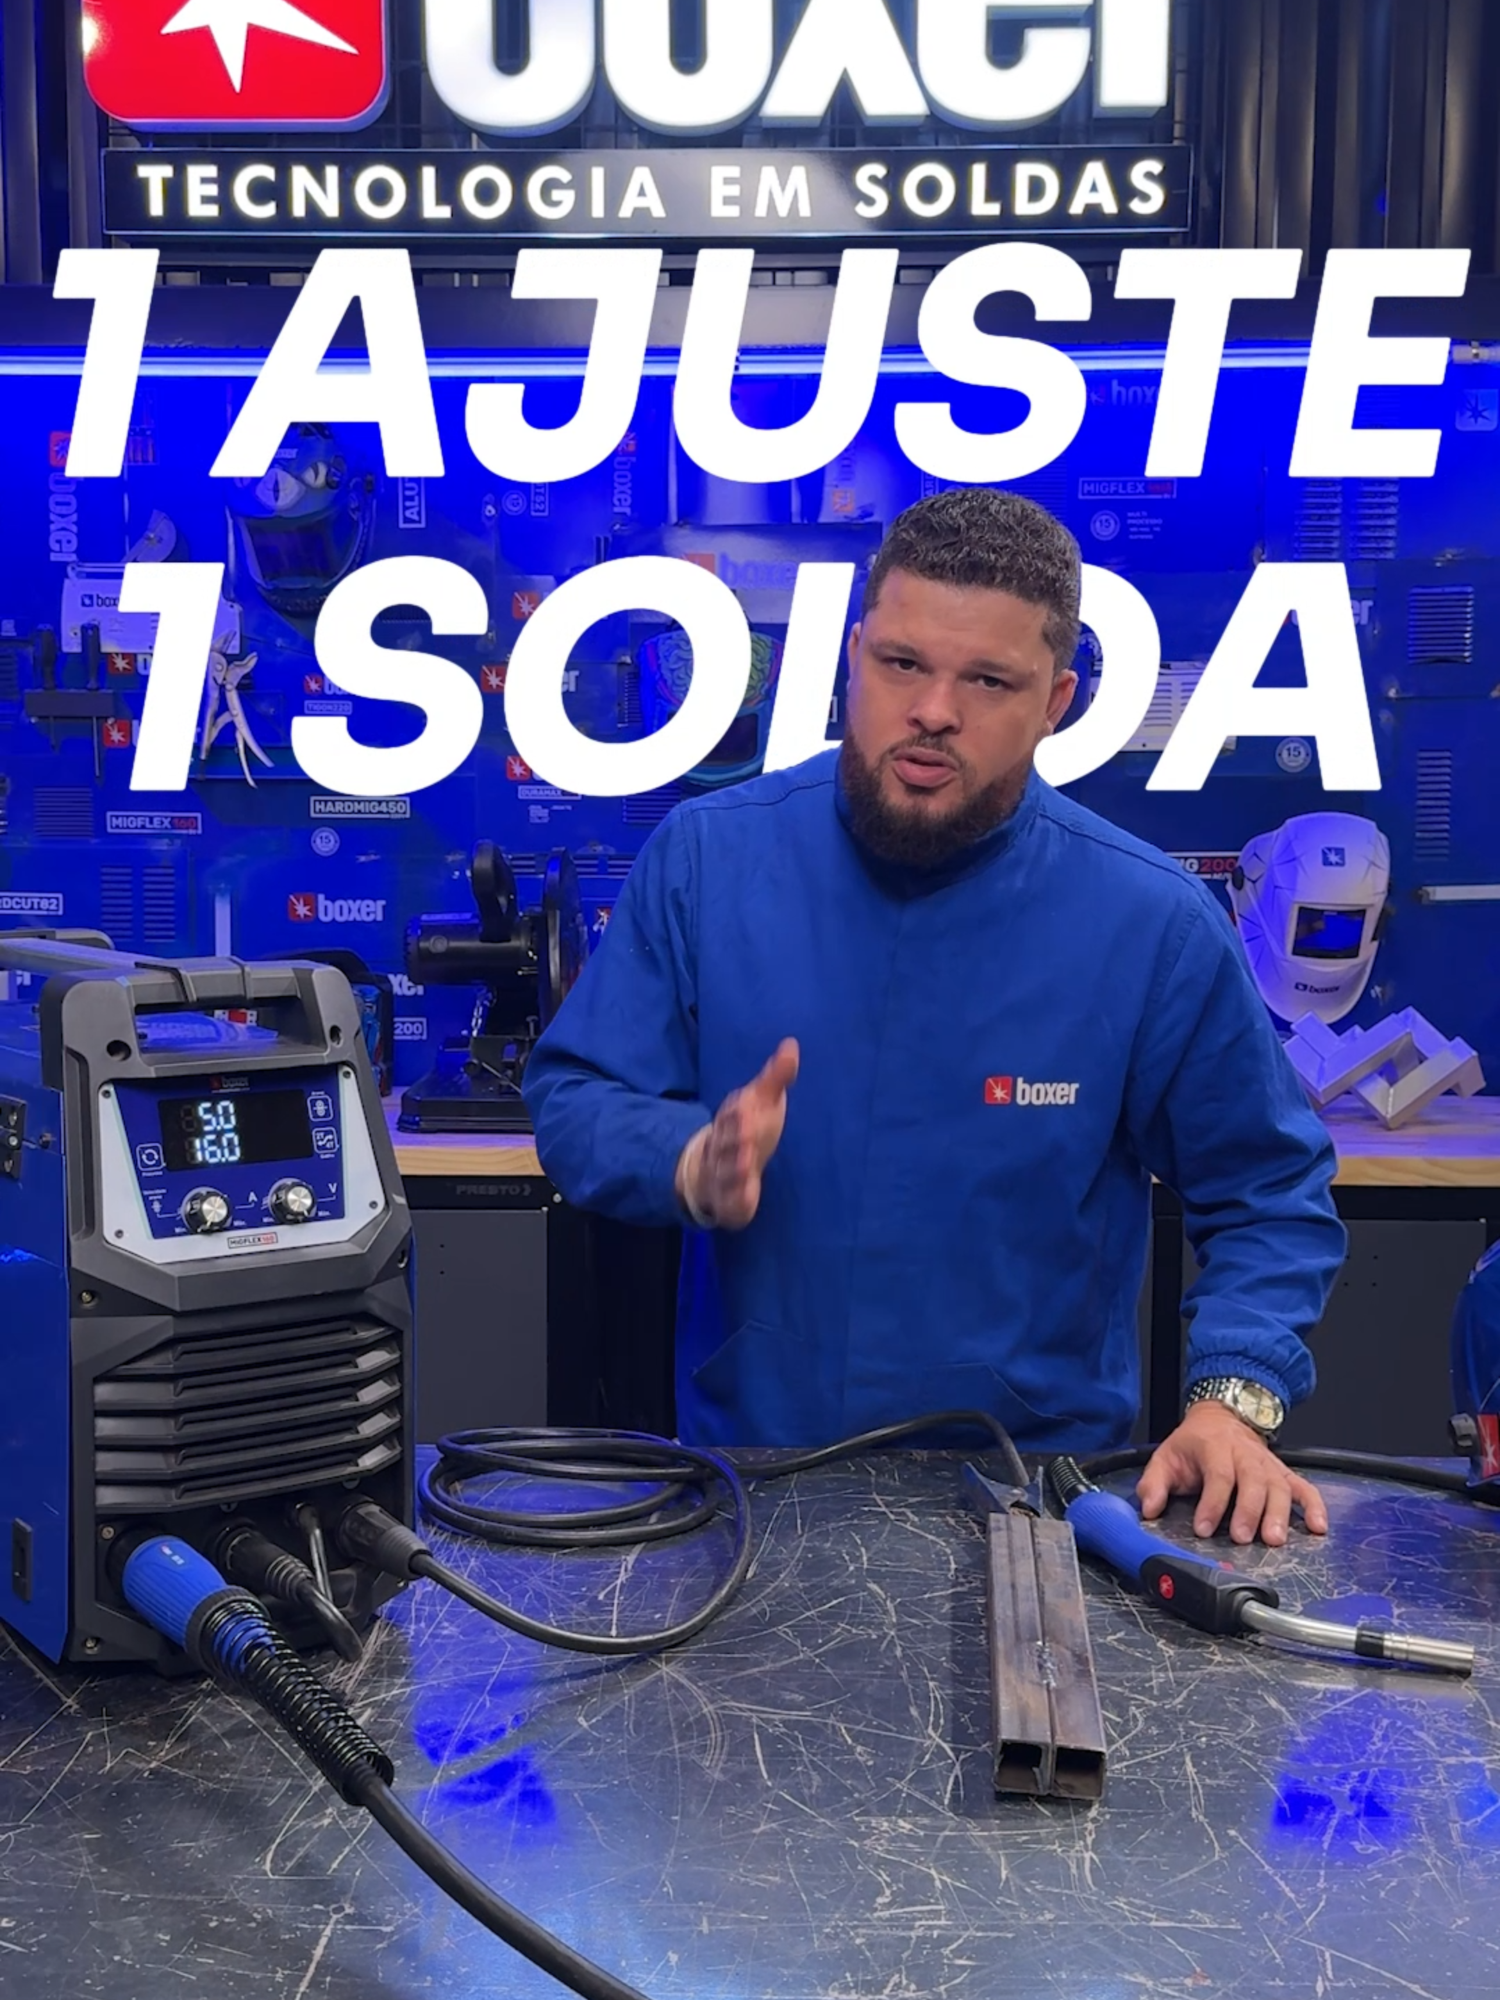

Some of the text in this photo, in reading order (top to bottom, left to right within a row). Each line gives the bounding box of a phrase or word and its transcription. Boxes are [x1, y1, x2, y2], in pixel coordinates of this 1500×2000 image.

[137, 160, 1167, 221] TECNOLOGIA EM SOLDAS
[613, 456, 637, 517] boxer
[315, 801, 406, 814] HARDMIG450
[318, 894, 387, 923] boxer
[1016, 1077, 1080, 1106] boxer
[197, 1100, 237, 1132] 5.0
[248, 1192, 258, 1203] A
[328, 1183, 338, 1193] V
[456, 1184, 521, 1196] PRESTO
